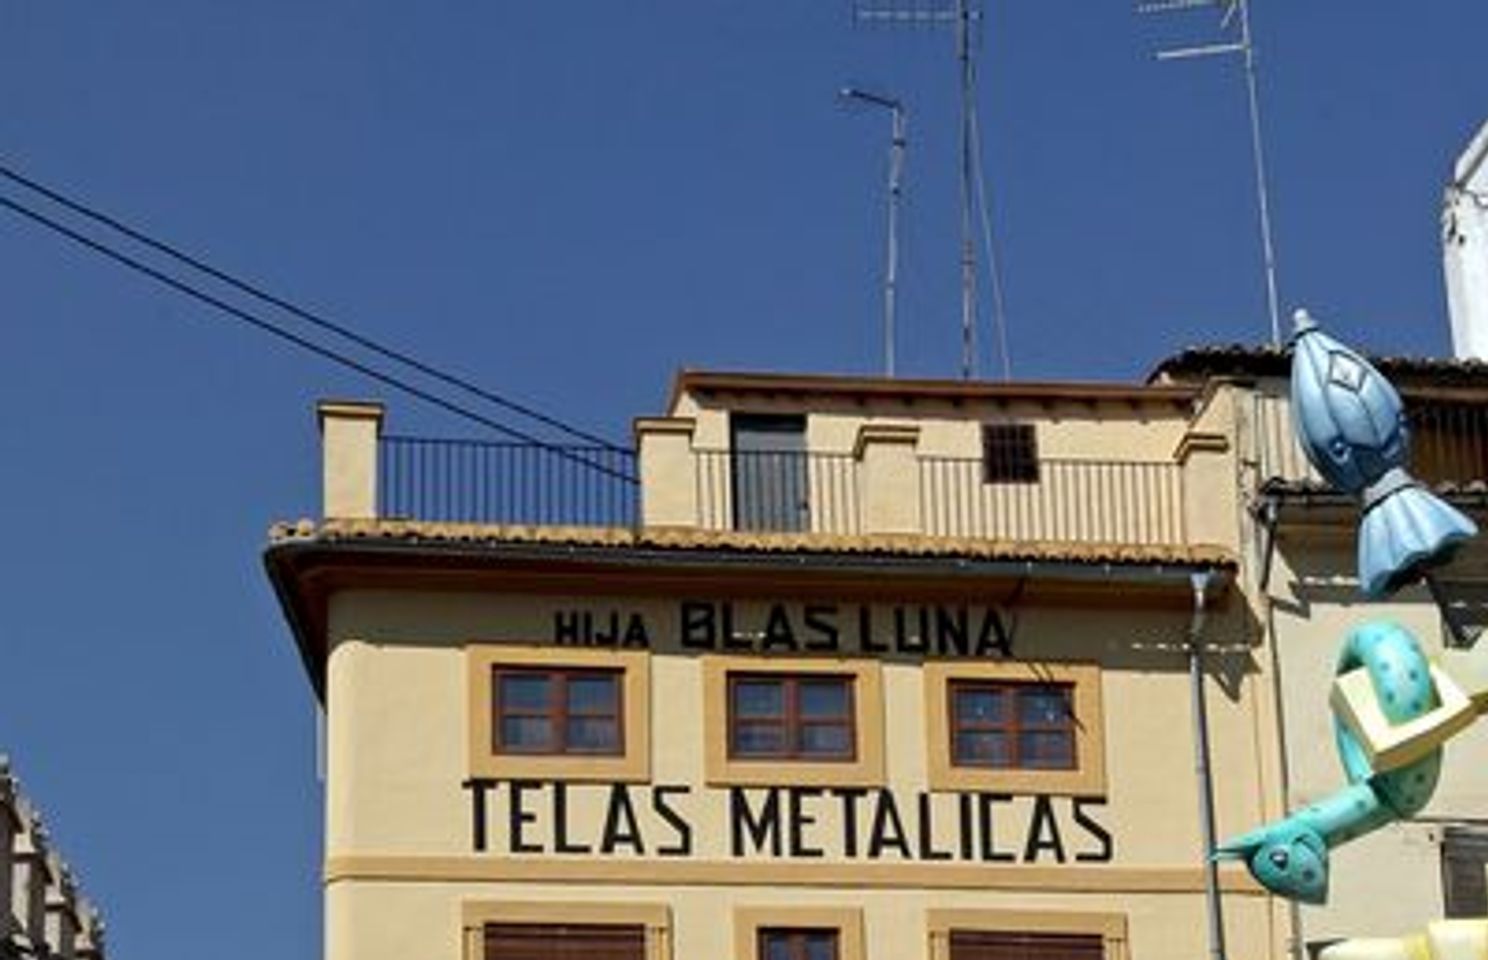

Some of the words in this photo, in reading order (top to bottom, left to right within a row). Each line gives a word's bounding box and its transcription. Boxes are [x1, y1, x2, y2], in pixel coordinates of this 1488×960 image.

[555, 609, 649, 648] HIJA
[681, 602, 839, 650] BLAS
[858, 605, 1014, 656] LUNA
[461, 778, 692, 855] TELAS
[729, 786, 1114, 863] METALICAS
